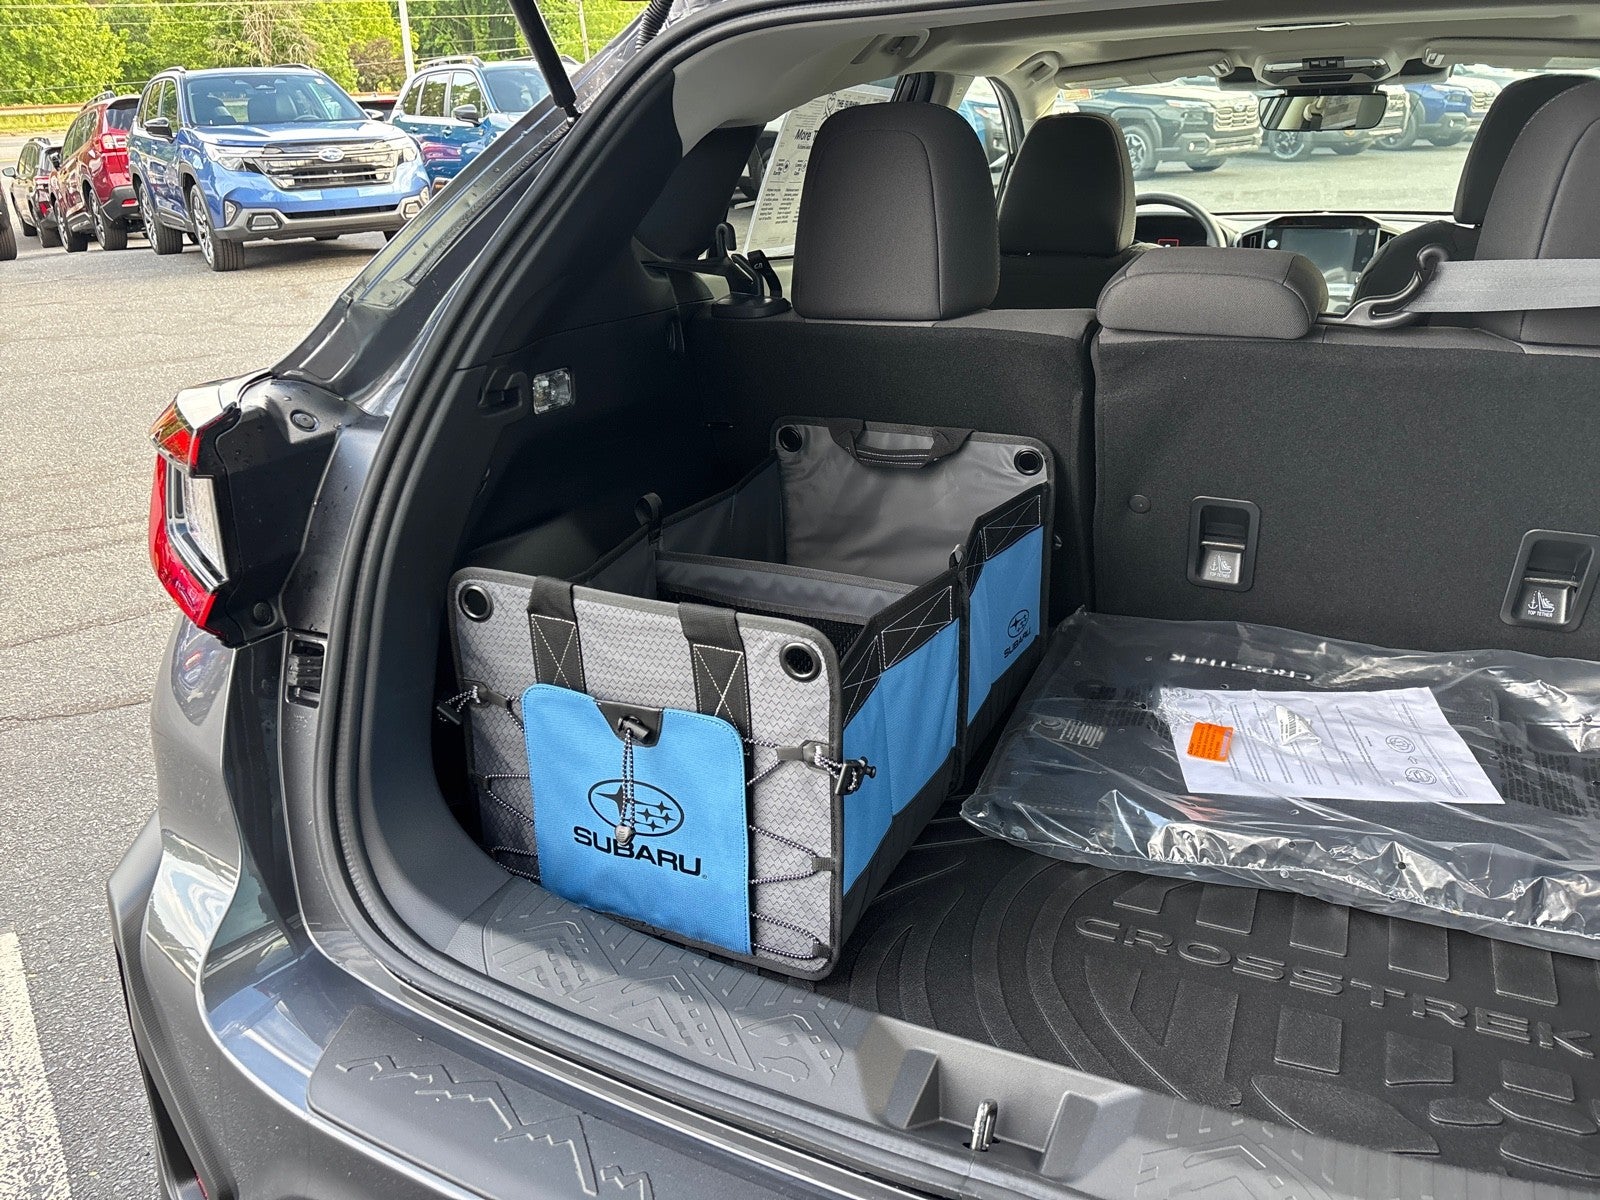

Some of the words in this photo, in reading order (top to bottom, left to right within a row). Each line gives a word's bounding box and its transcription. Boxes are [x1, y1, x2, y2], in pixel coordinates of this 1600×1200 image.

[795, 128, 812, 141] More
[573, 825, 702, 877] SUBARU
[1074, 914, 1596, 1058] CROSSTREK
